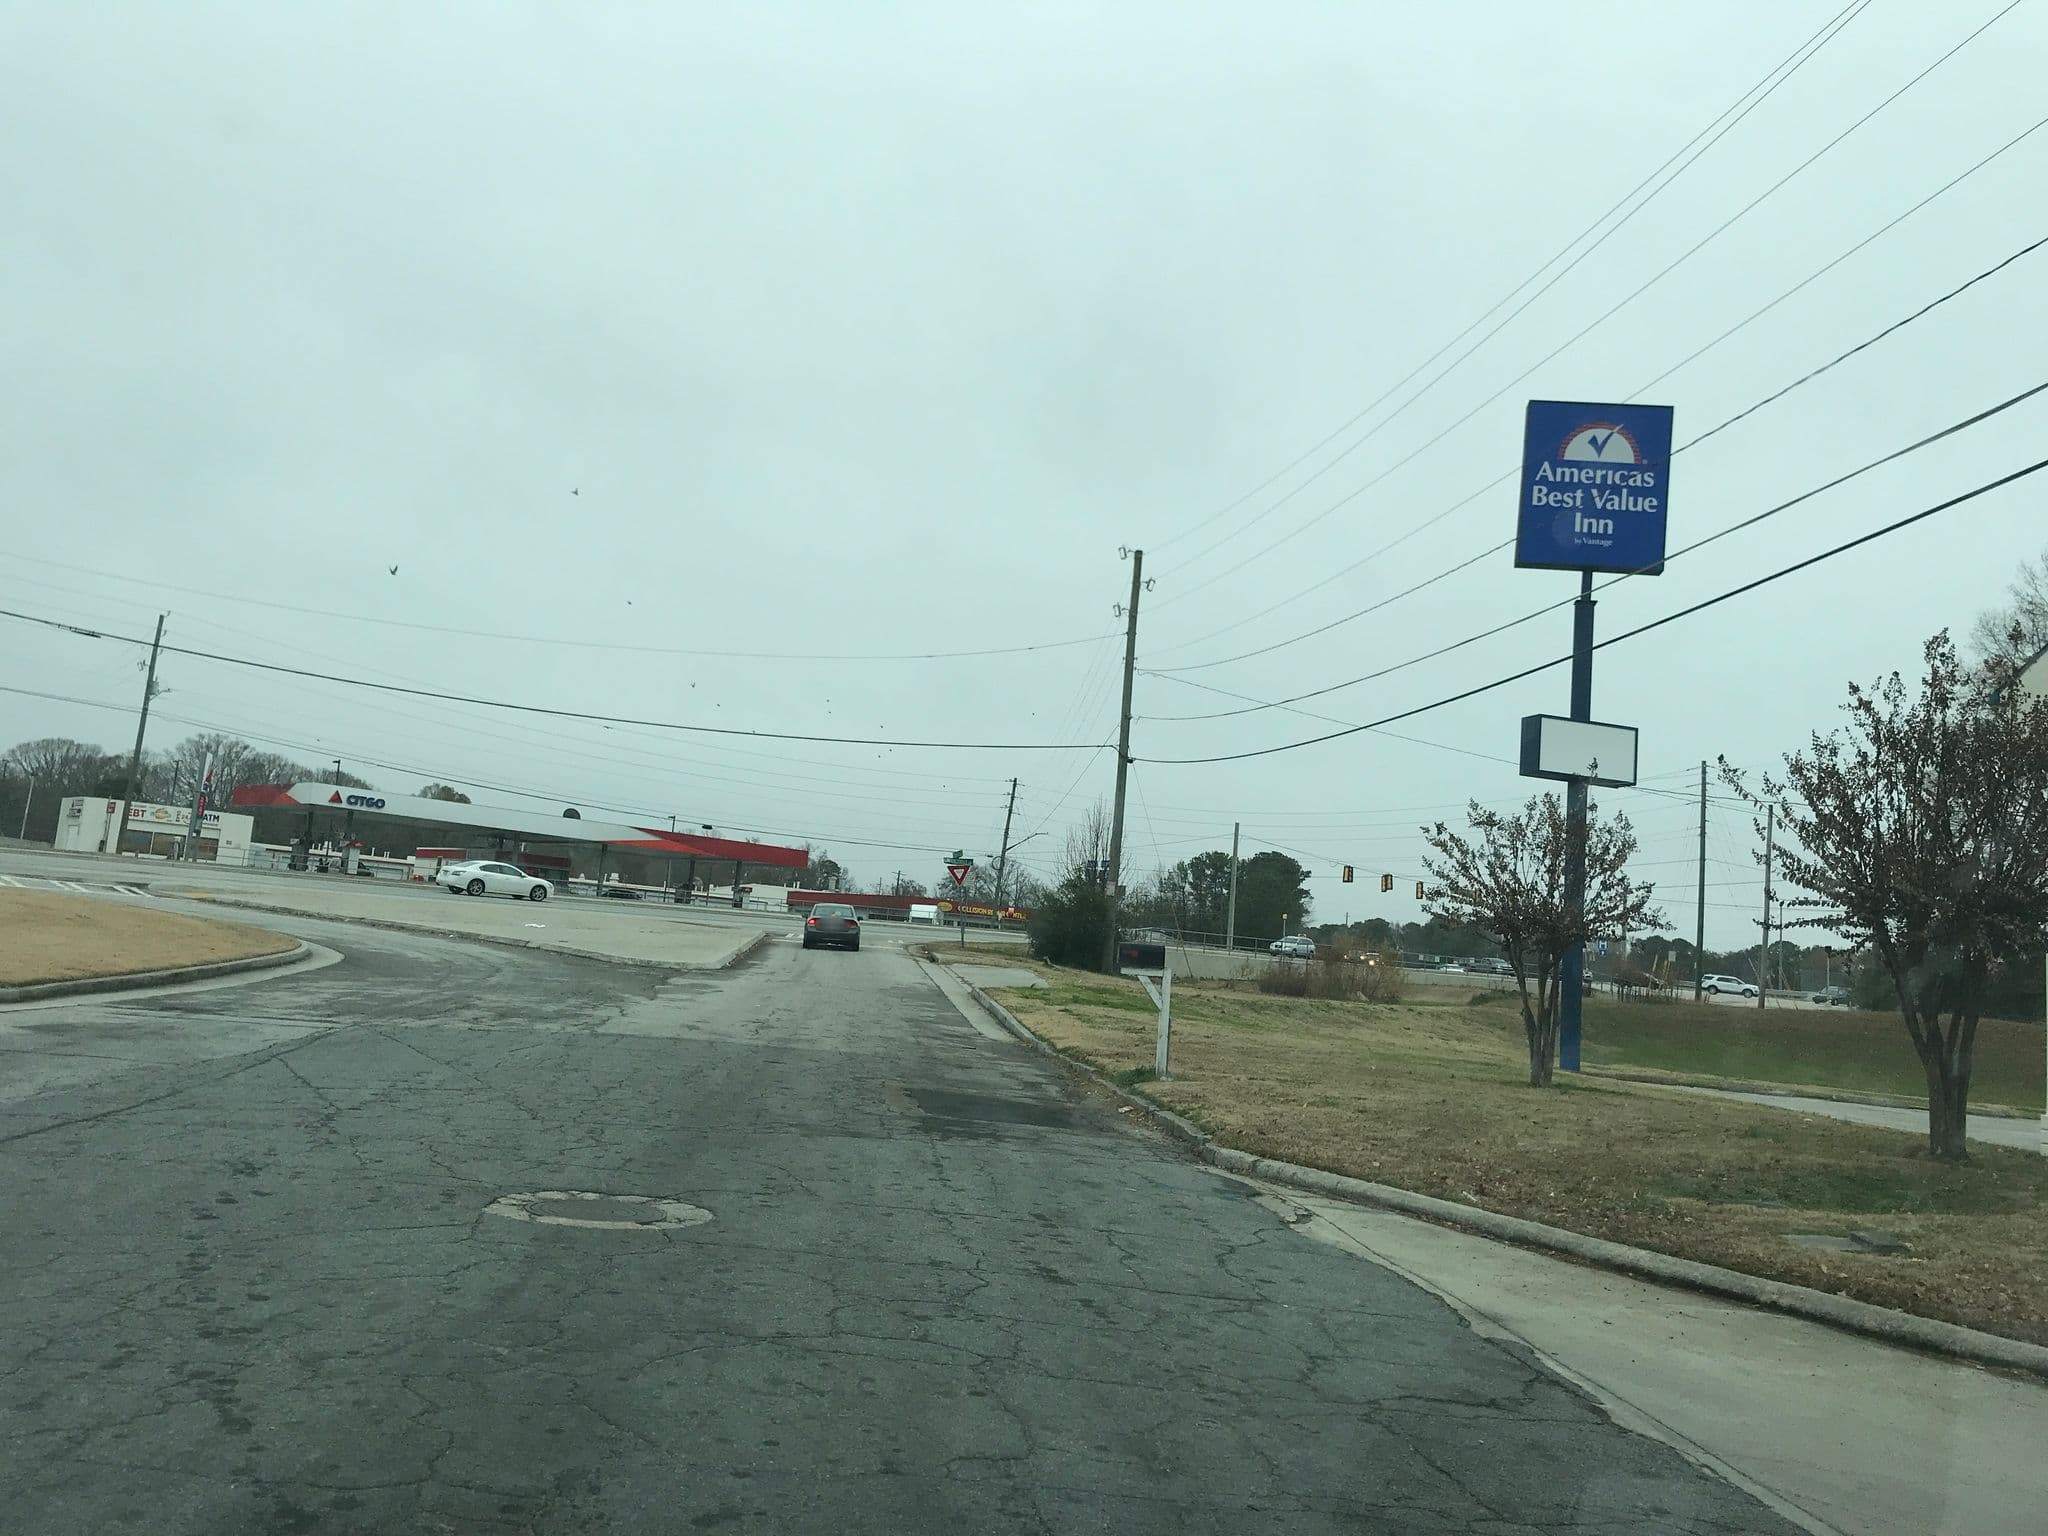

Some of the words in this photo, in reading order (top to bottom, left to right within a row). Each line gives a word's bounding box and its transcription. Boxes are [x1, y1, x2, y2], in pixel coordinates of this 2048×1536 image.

[1535, 461, 1655, 487] Americas
[1532, 485, 1584, 509] Best
[1591, 488, 1658, 513] Value
[1574, 512, 1614, 535] Inn
[1582, 537, 1613, 548] Vantage
[346, 794, 386, 809] CITGO
[203, 813, 220, 823] ATM
